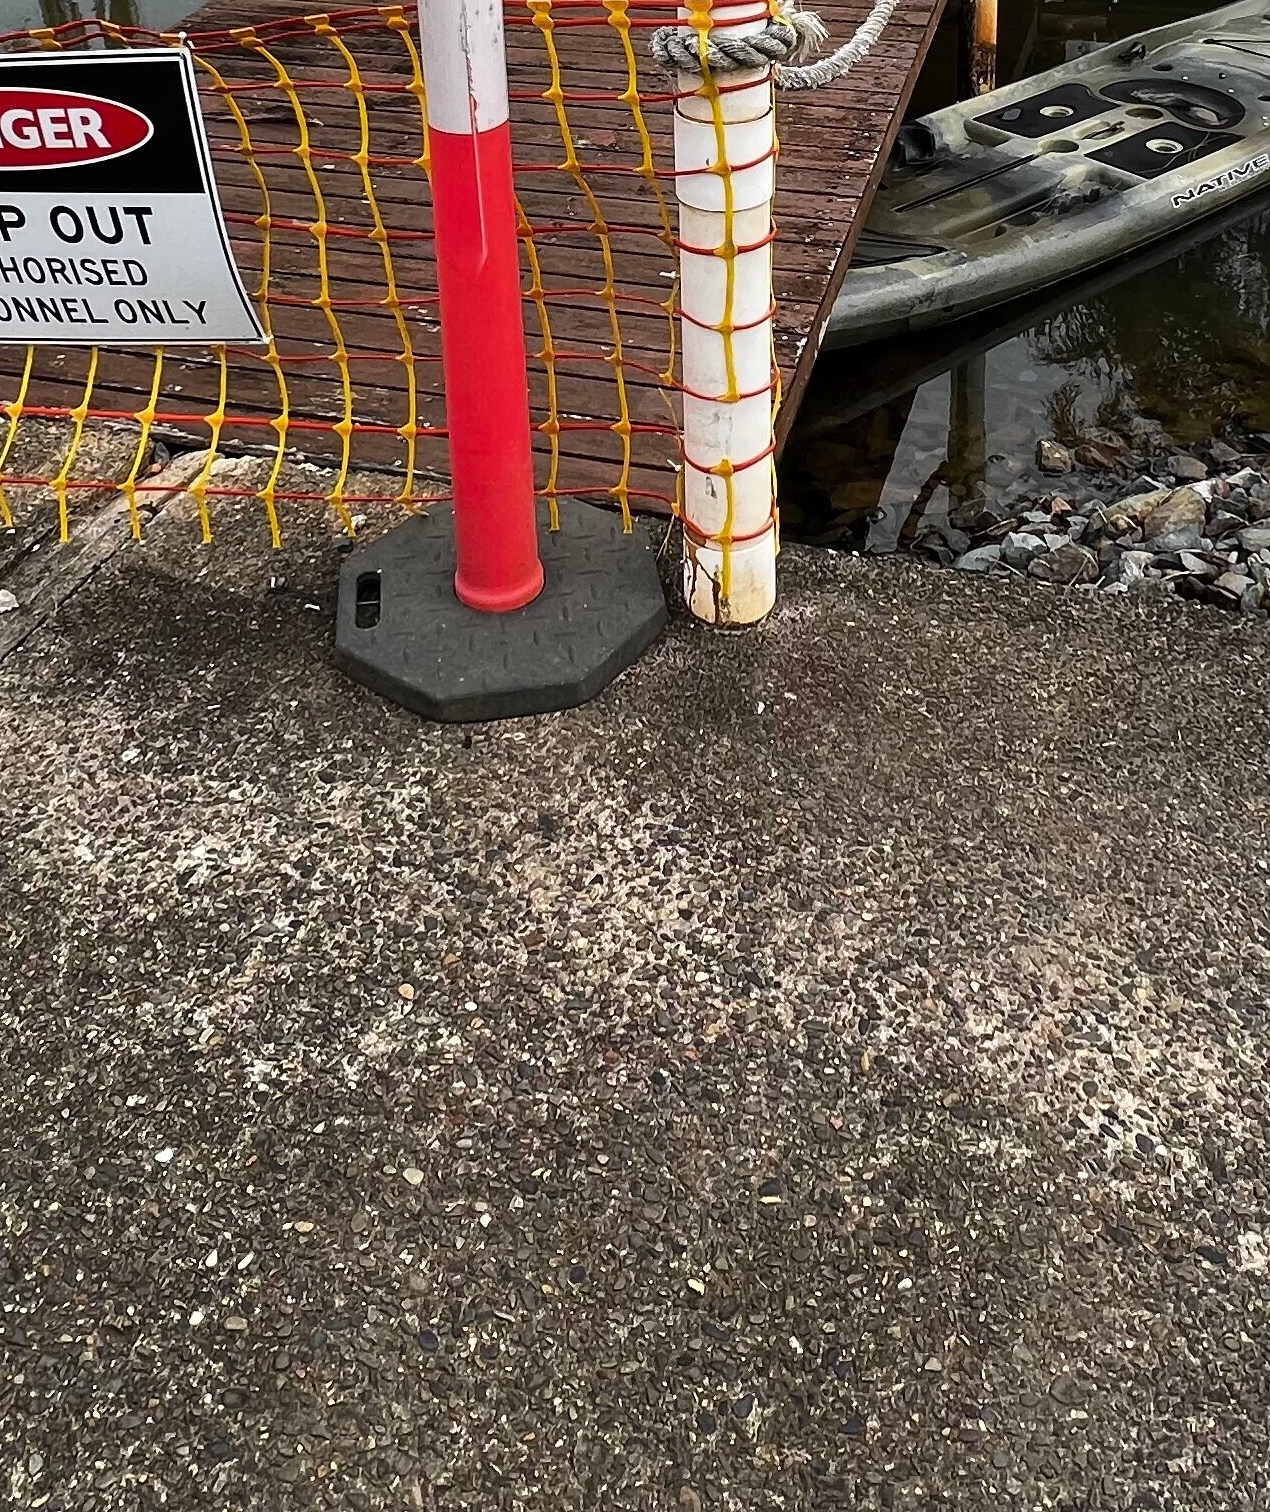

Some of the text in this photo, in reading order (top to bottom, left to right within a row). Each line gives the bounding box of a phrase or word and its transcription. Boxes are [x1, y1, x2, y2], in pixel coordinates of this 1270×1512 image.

[1172, 154, 1269, 207] NATIVE
[49, 205, 153, 245] OUT
[114, 298, 207, 325] ONLY
